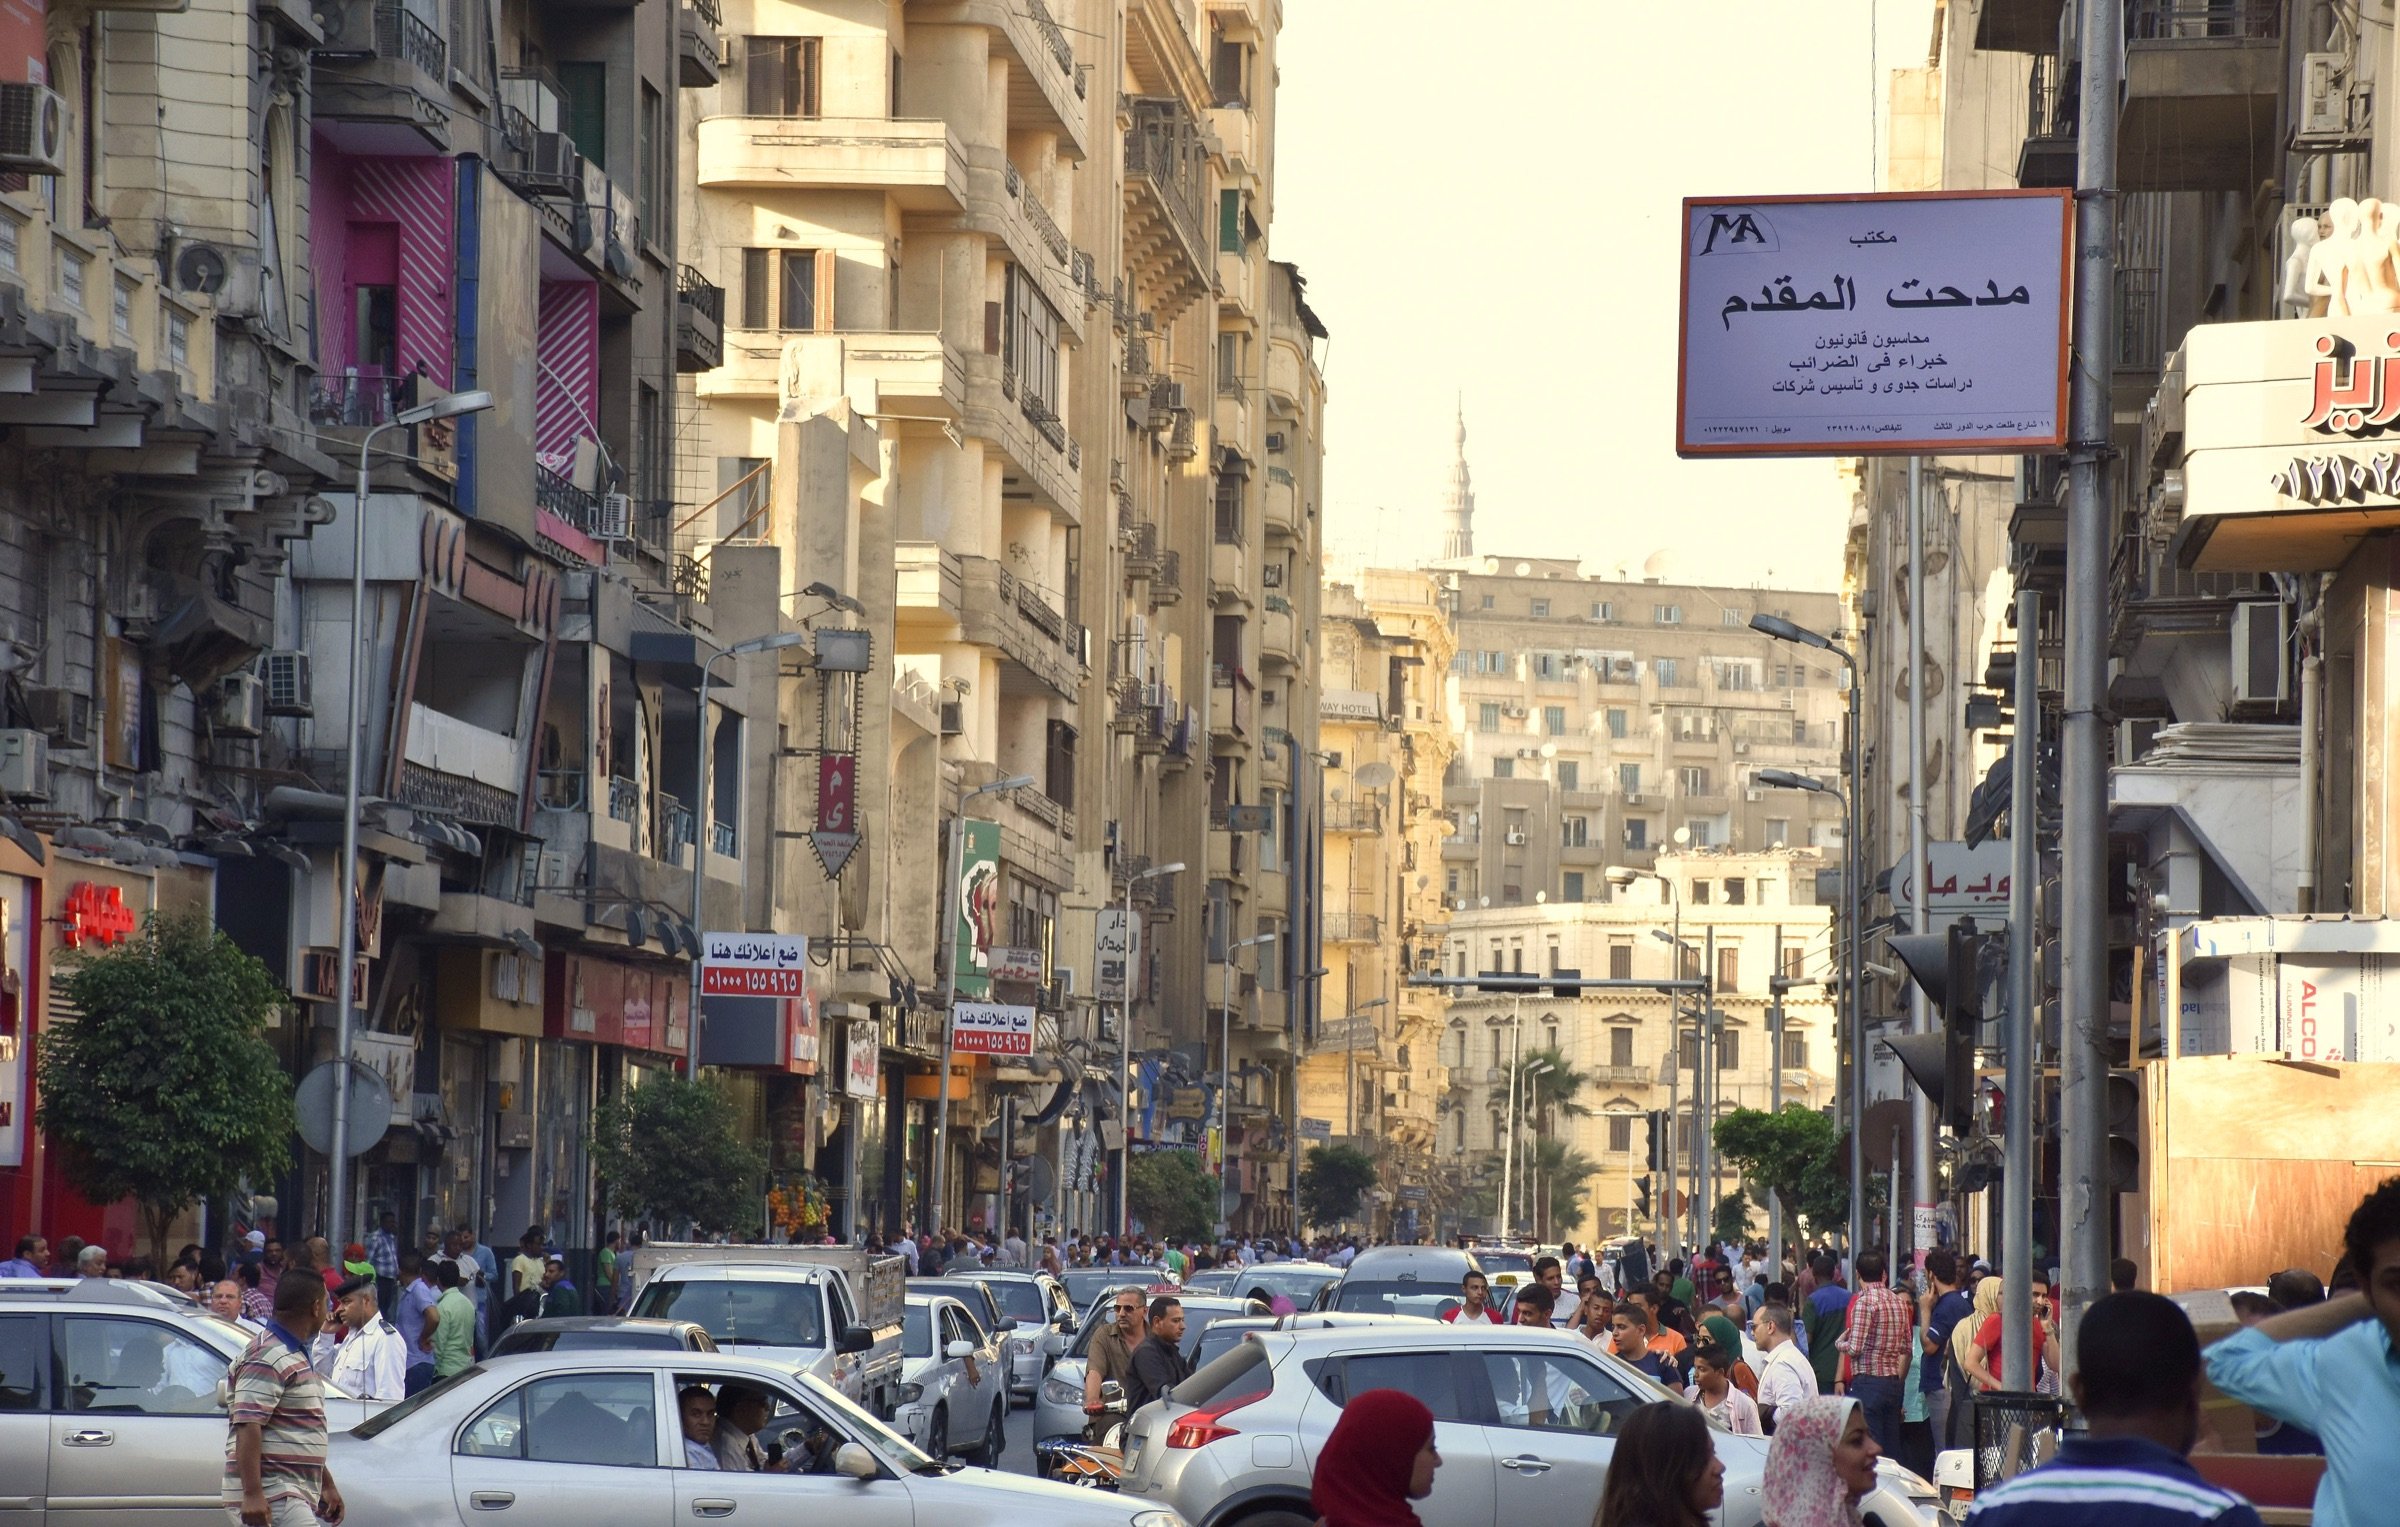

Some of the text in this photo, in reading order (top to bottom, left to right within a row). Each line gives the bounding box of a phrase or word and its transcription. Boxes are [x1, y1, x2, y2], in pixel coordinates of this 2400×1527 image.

[1700, 214, 1766, 255] MA
[1850, 231, 1897, 248] مكتب
[1722, 274, 2030, 331] مدحت المقدم
[1815, 330, 1930, 349] محاسبون قانونيون
[1789, 352, 1948, 372] خبراء فى الضرائب
[1772, 376, 1973, 395] دراسات جدوى و تأسيس شركات
[1957, 422, 1974, 432] الدور
[1976, 423, 1993, 431] حرب
[1996, 420, 2015, 429] طلعت
[2016, 420, 2037, 431] شارع
[1342, 703, 1374, 715] HOTEL
[711, 942, 731, 959] هنا
[778, 945, 798, 967] ضع
[709, 969, 797, 993] ٠١٠٠٠ ١٥٥ ٩٦٥
[959, 1010, 975, 1024] هنا
[1012, 1014, 1028, 1031] ضع
[2302, 980, 2317, 1061] ALCO
